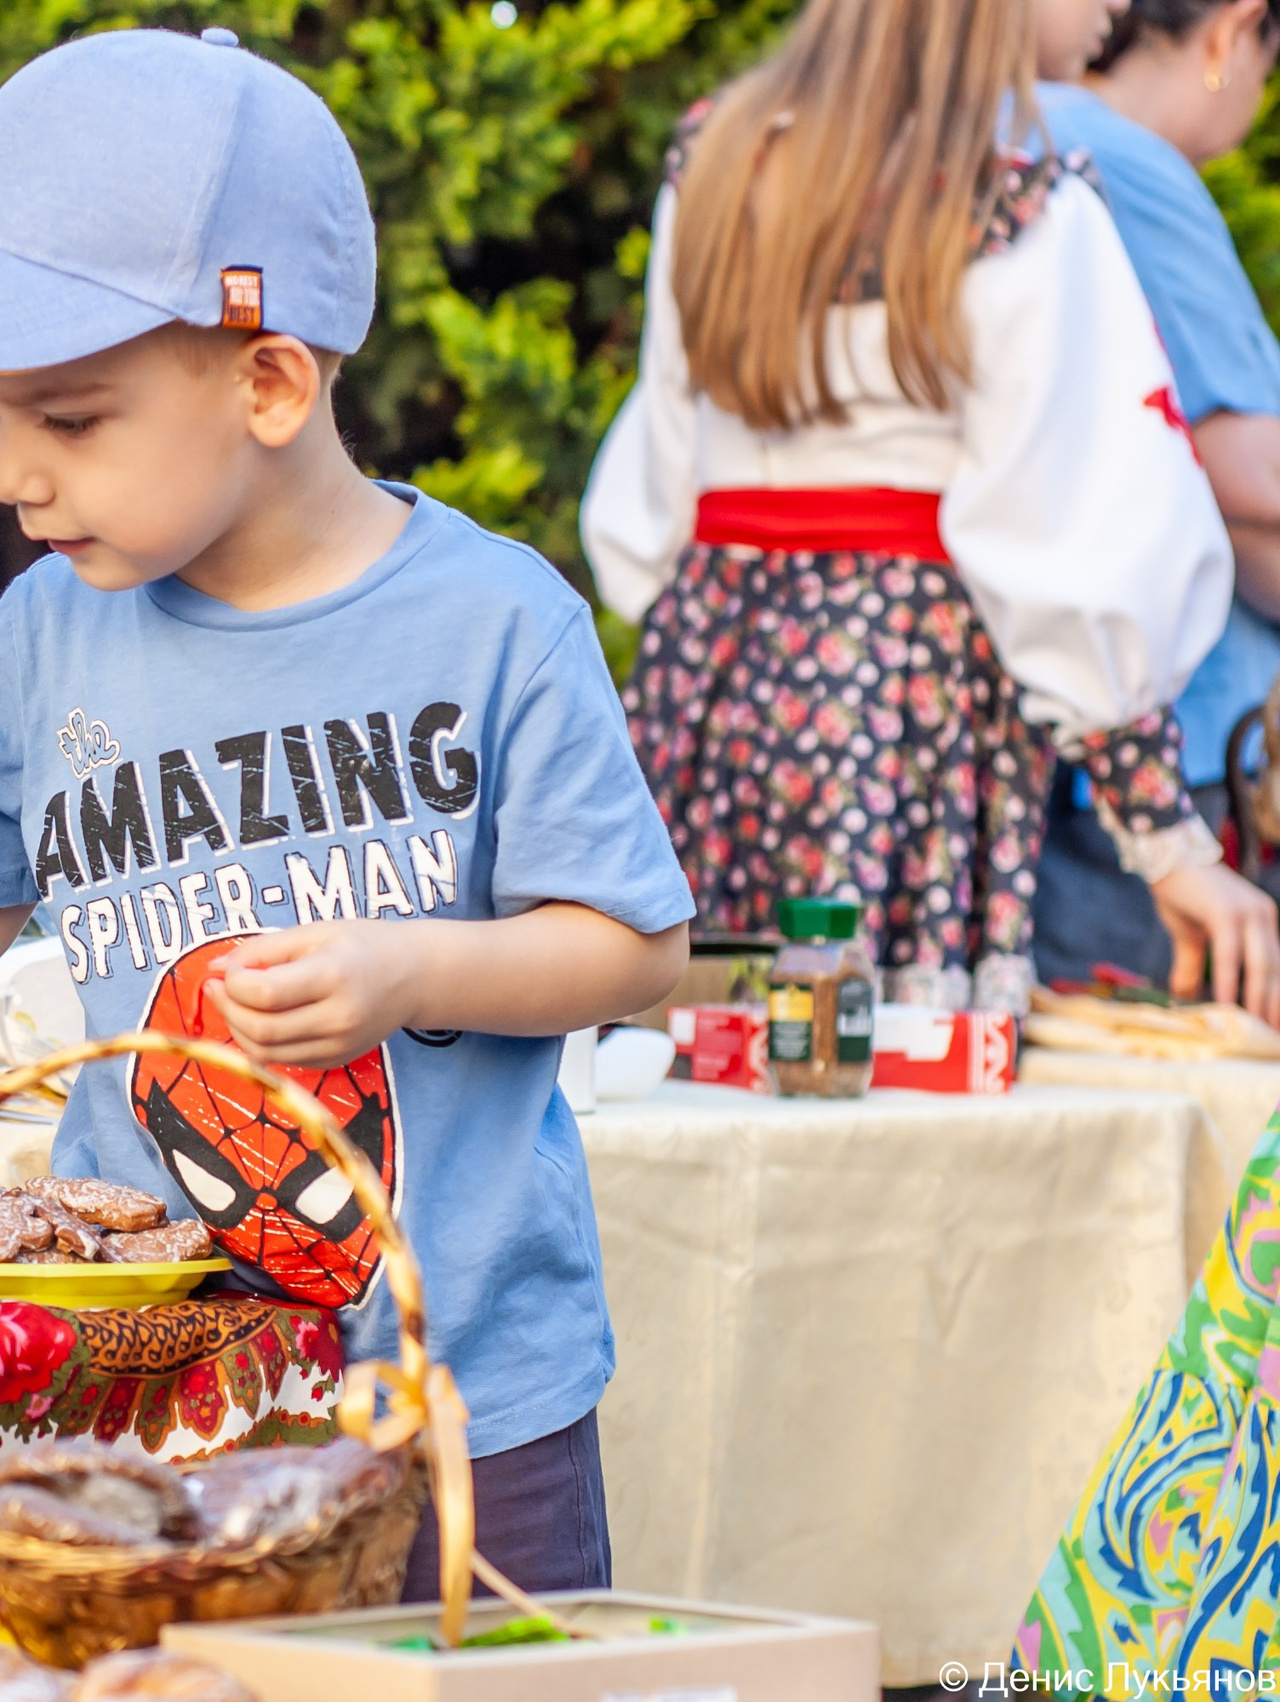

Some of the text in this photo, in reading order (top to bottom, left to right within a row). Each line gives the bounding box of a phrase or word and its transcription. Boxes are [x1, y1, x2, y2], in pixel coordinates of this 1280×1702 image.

[35, 701, 482, 901] AMAZING
[59, 707, 122, 780] the
[60, 828, 460, 986] SPIDER-MAN
